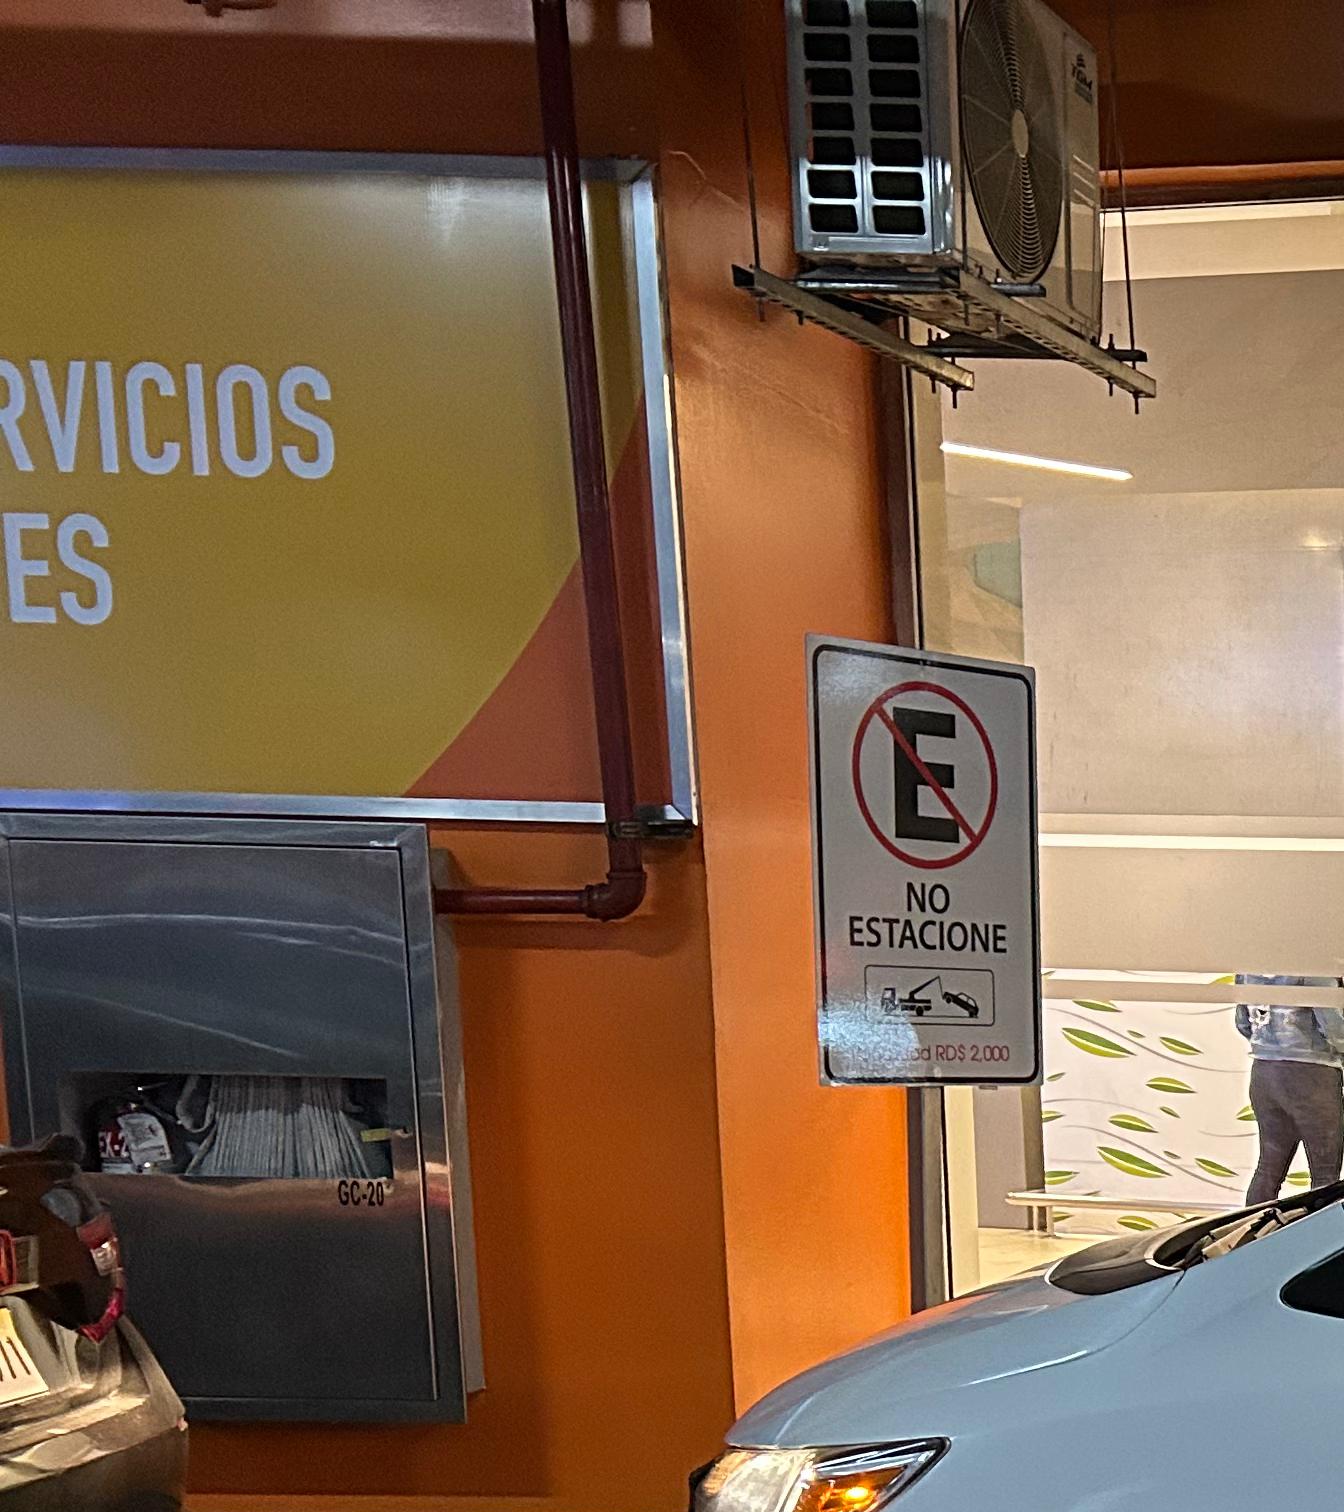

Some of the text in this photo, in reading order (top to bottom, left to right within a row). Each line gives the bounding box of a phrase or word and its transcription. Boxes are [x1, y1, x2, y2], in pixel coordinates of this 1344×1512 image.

[3, 512, 114, 625] ES
[905, 881, 951, 915] NO
[848, 915, 1008, 954] ESTACIONE
[935, 1043, 967, 1064] RD$
[969, 1044, 1011, 1063] 2,000
[337, 1179, 385, 1207] GC-20
